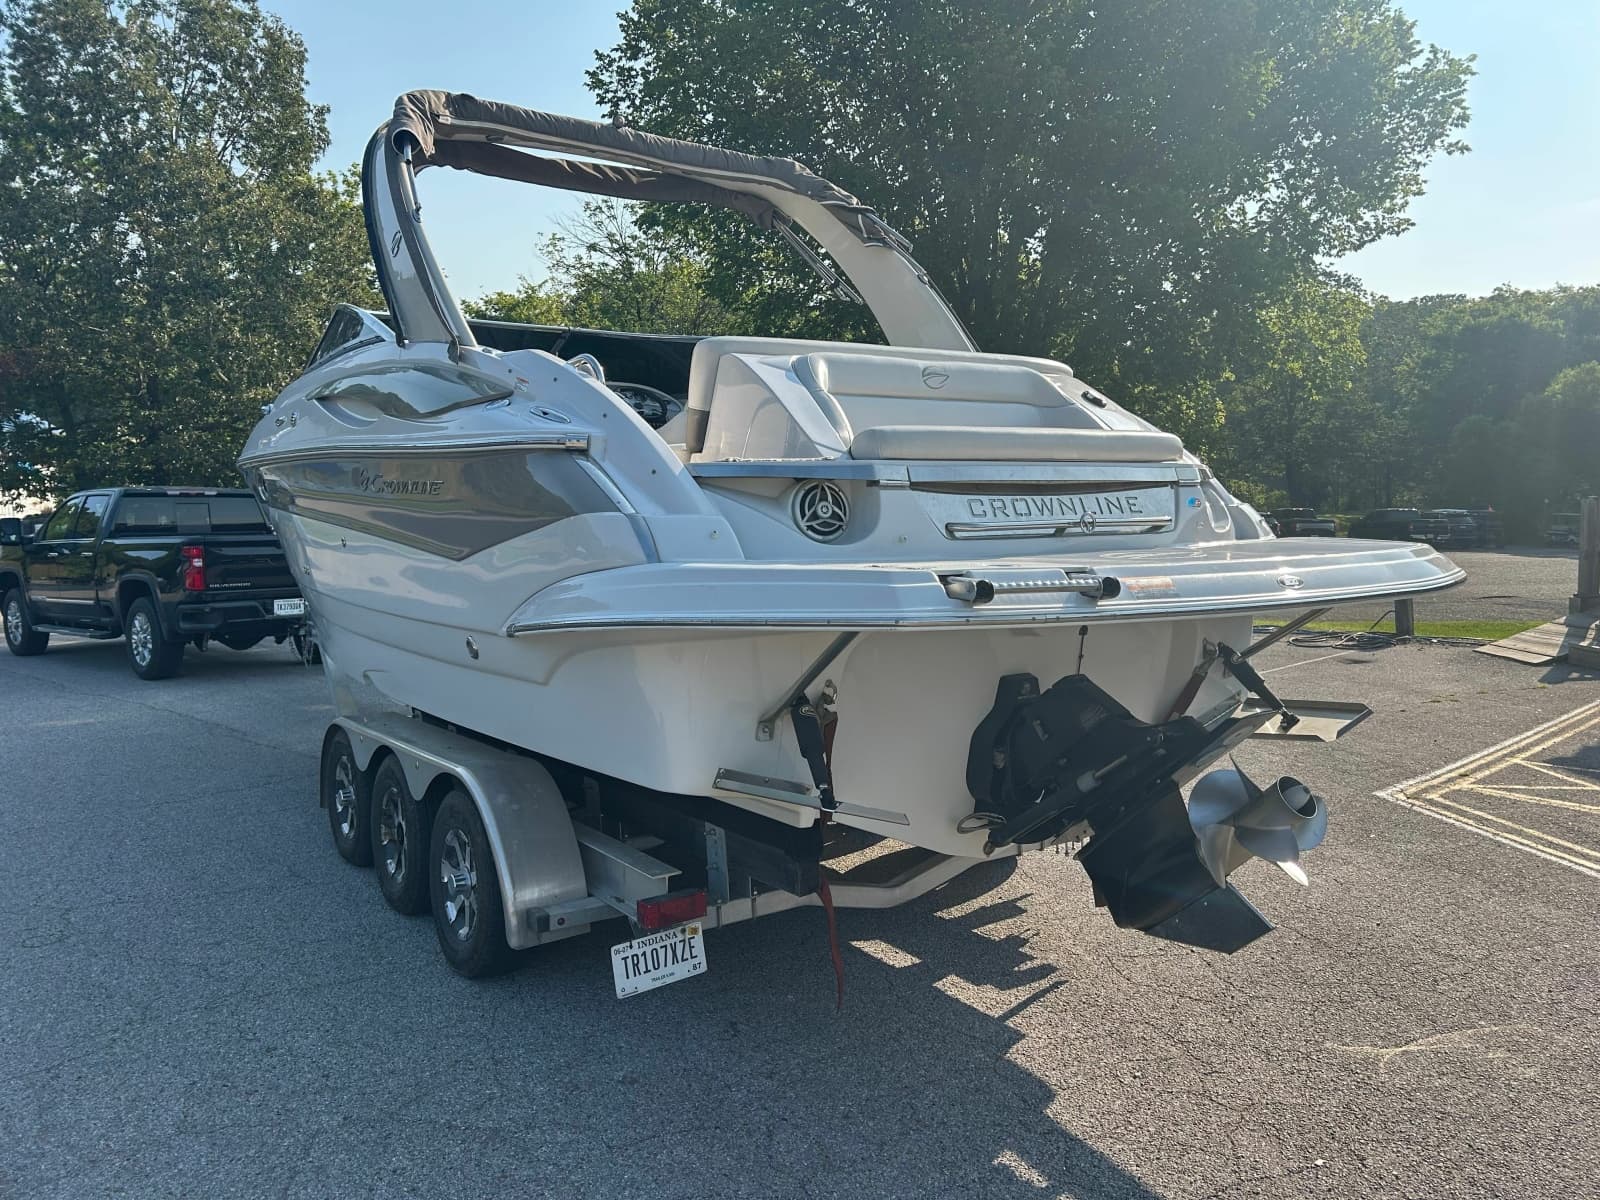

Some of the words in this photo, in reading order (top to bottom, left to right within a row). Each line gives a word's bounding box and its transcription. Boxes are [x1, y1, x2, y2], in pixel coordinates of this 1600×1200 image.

[967, 496, 1143, 518] CROWNLINE
[637, 931, 678, 949] INDIANA
[621, 936, 698, 980] TR107XZE
[692, 962, 702, 971] 87
